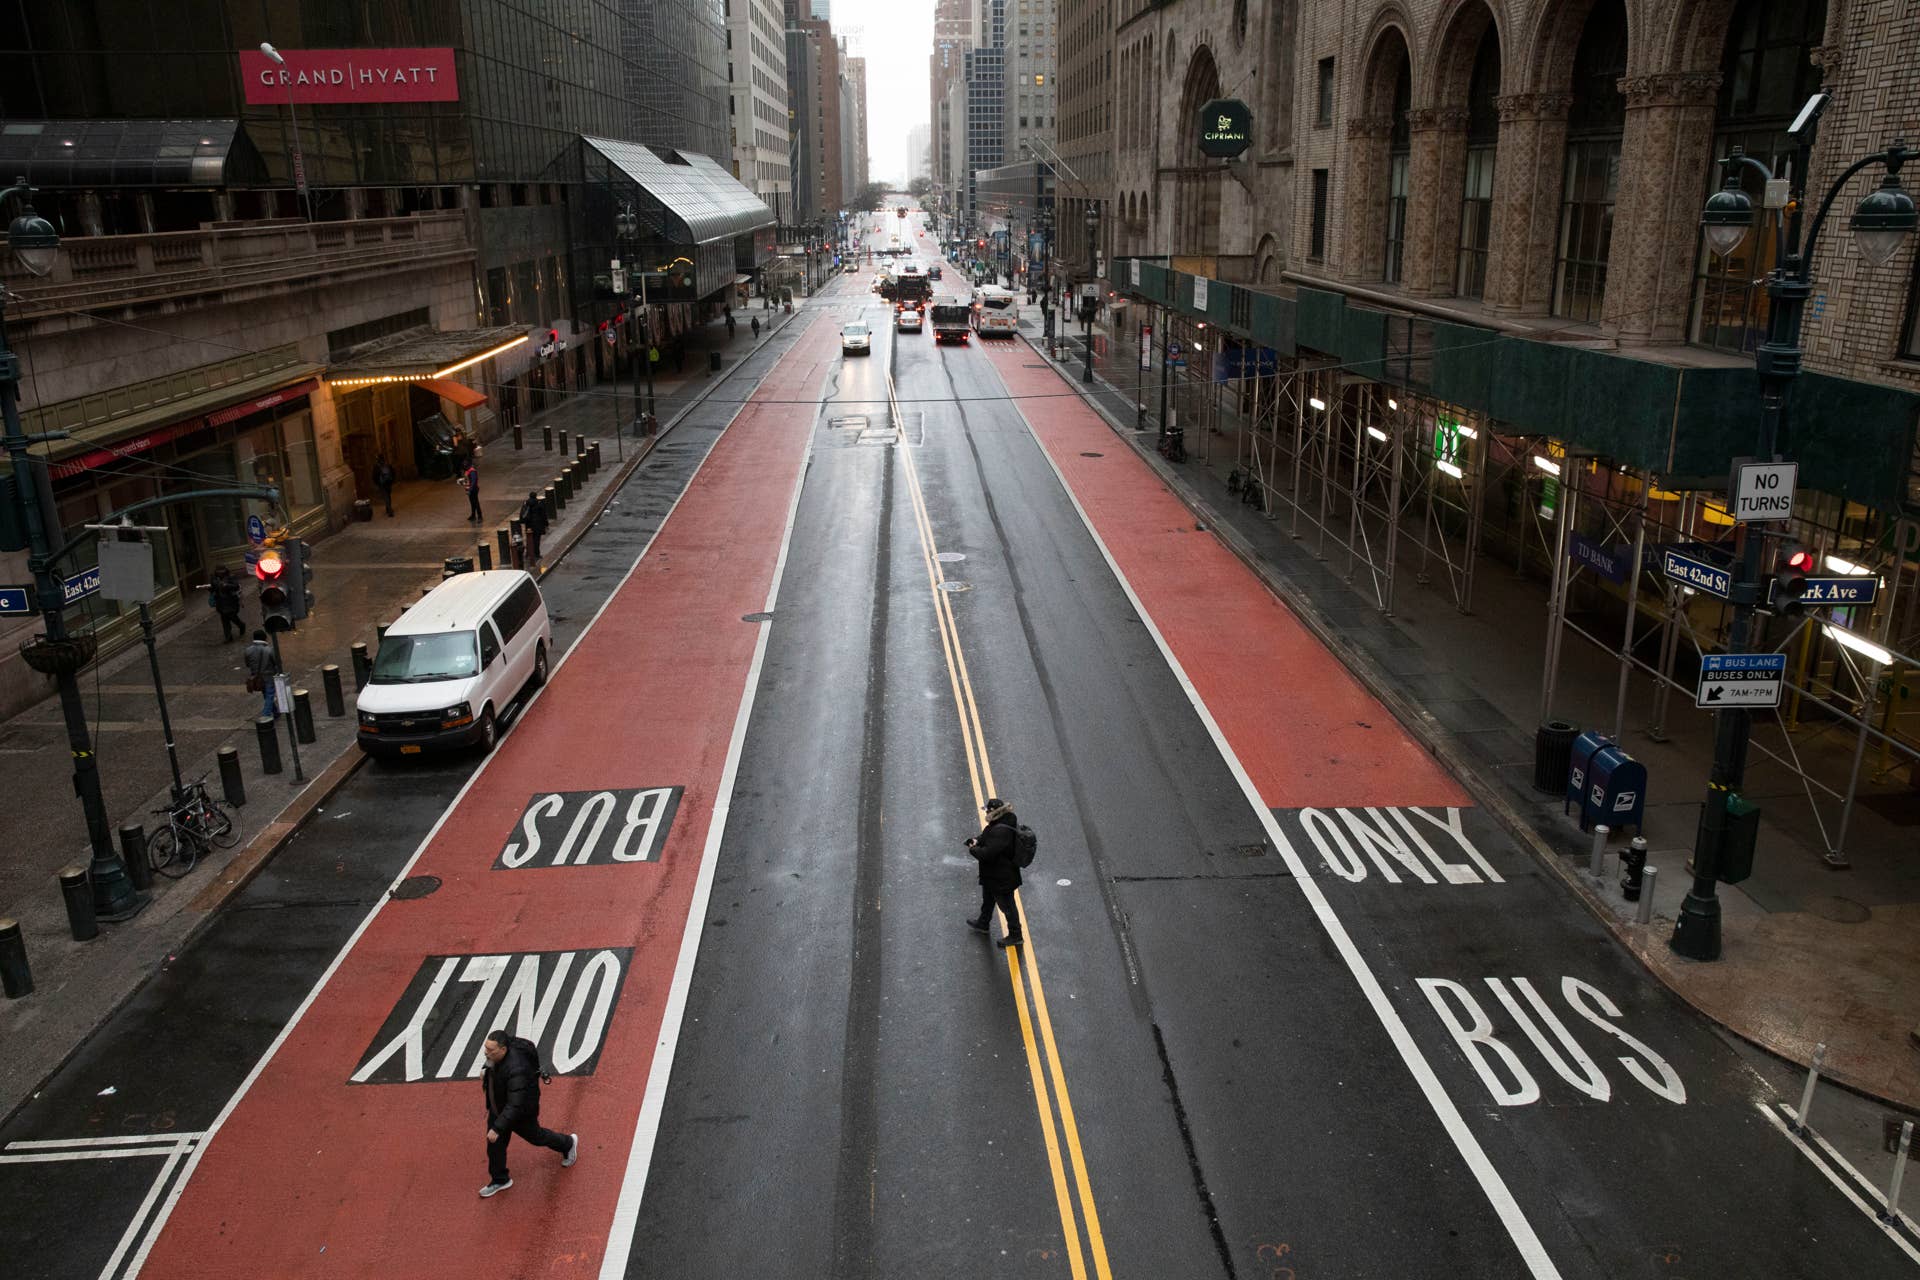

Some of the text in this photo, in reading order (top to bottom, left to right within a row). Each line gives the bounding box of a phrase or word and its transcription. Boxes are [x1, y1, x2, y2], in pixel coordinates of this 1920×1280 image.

[260, 67, 438, 86] GRAND HYATT
[1204, 132, 1244, 140] CIPRIANI
[1755, 473, 1779, 490] NO
[1740, 496, 1790, 512] TURNS
[1577, 542, 1615, 574] TD BANK
[1667, 557, 1727, 593] East 42nd St
[64, 582, 83, 599] East
[1826, 585, 1858, 599] Ave
[1725, 658, 1779, 667] BUS LANE
[1707, 671, 1776, 680] BUSES ONLY
[1730, 688, 1773, 696] 7AM-7PM
[501, 787, 673, 868] BUS
[1300, 807, 1505, 883] ONLY
[350, 950, 622, 1082] ONLY
[1415, 977, 1686, 1105] BUS
